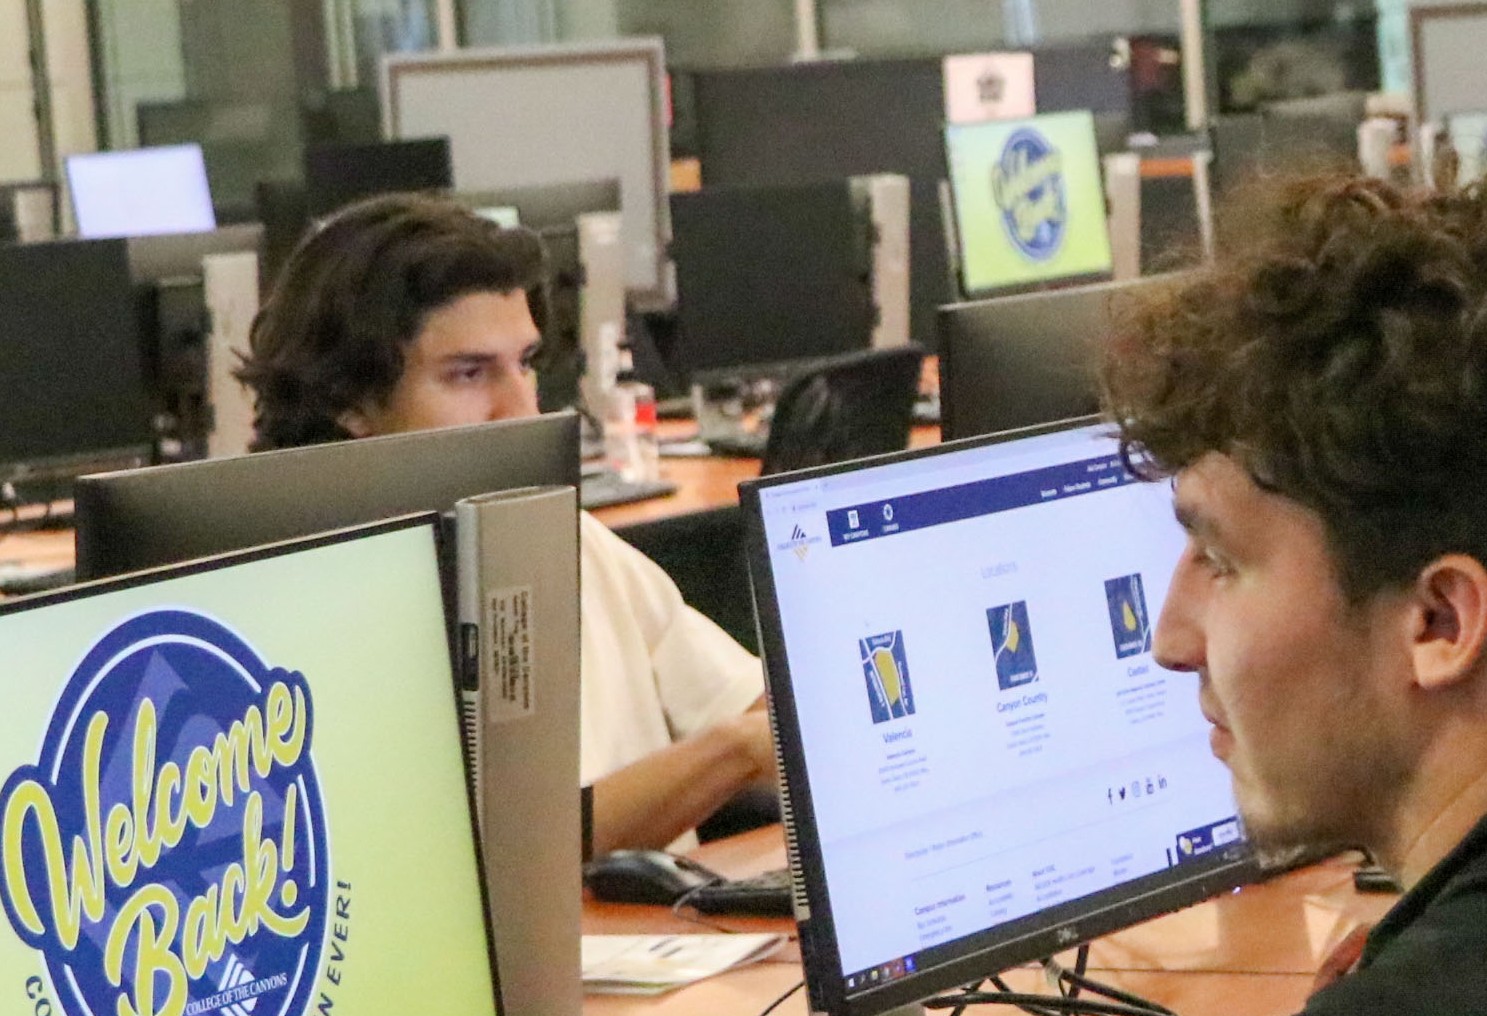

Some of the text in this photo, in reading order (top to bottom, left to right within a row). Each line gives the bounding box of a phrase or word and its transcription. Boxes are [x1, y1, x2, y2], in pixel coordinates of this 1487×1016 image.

[4, 682, 306, 951] Welcome
[326, 880, 352, 987] EVER!
[186, 972, 288, 1016] COLLEGE OF THE CANYONS
